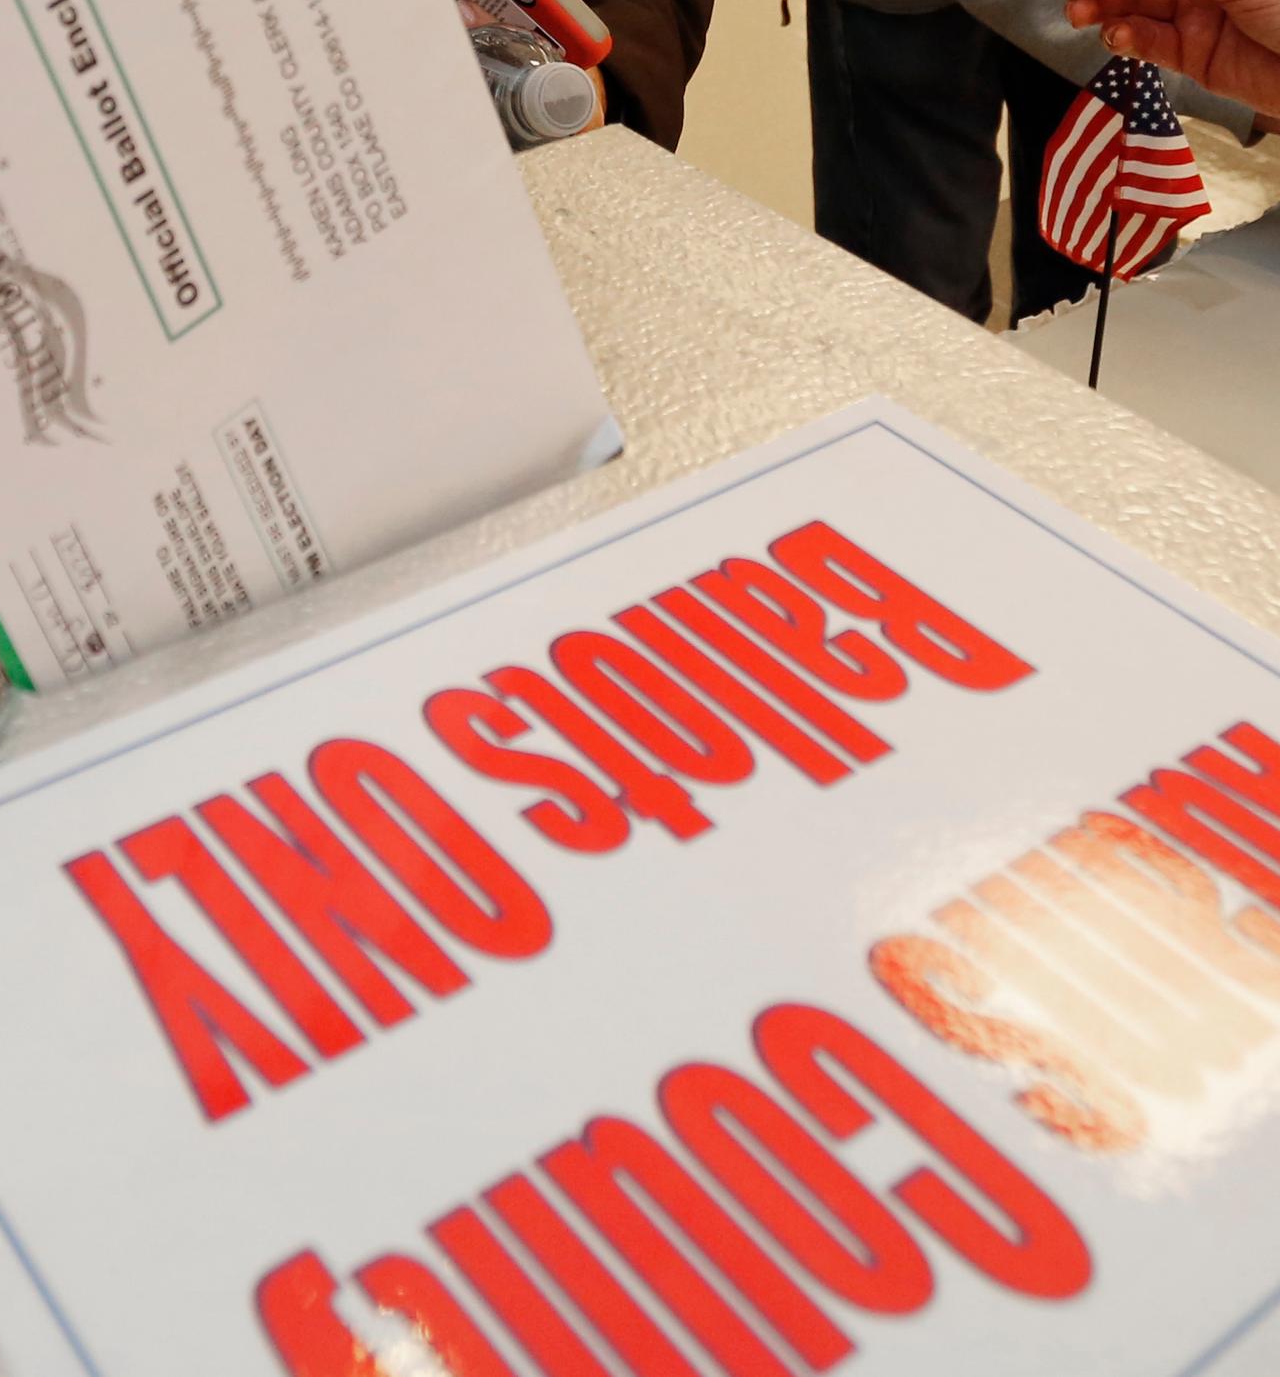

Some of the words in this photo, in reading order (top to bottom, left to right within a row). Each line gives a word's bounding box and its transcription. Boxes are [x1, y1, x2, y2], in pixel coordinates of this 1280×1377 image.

[258, 5, 298, 79] CLERK
[288, 84, 334, 170] COUNTY
[324, 102, 352, 149] 1540
[338, 75, 363, 111] CO
[88, 80, 145, 183] Ballot
[279, 124, 316, 186] LONG
[353, 113, 407, 219] EASTLAKE
[325, 172, 366, 244] ADAMS
[345, 152, 374, 200] BOX
[133, 189, 198, 307] Official
[307, 186, 345, 259] KAREN
[364, 199, 388, 233] PO
[241, 417, 269, 455] DAY
[259, 455, 313, 551] ELECTION
[422, 519, 1038, 856] Ballots
[62, 737, 555, 1127] ONLY
